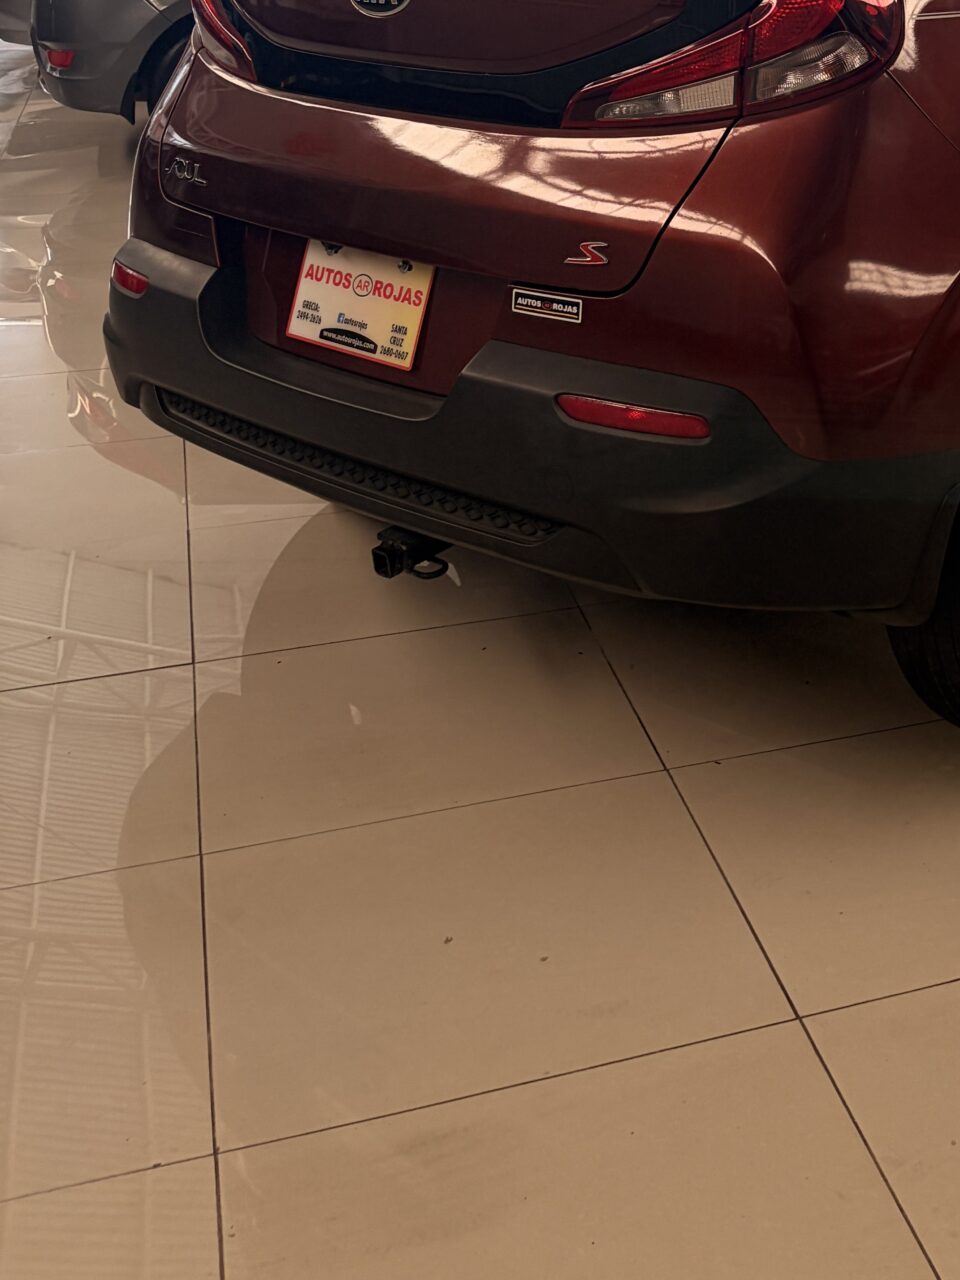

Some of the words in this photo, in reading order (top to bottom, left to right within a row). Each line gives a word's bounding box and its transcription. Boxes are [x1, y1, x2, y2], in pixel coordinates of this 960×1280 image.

[563, 241, 608, 265] S
[304, 263, 352, 289] AUTOS
[372, 279, 424, 307] ROJAS
[517, 297, 541, 307] AUTOS
[552, 303, 578, 313] ROJAS
[391, 324, 408, 336] SANTA
[389, 336, 405, 348] CRUZ
